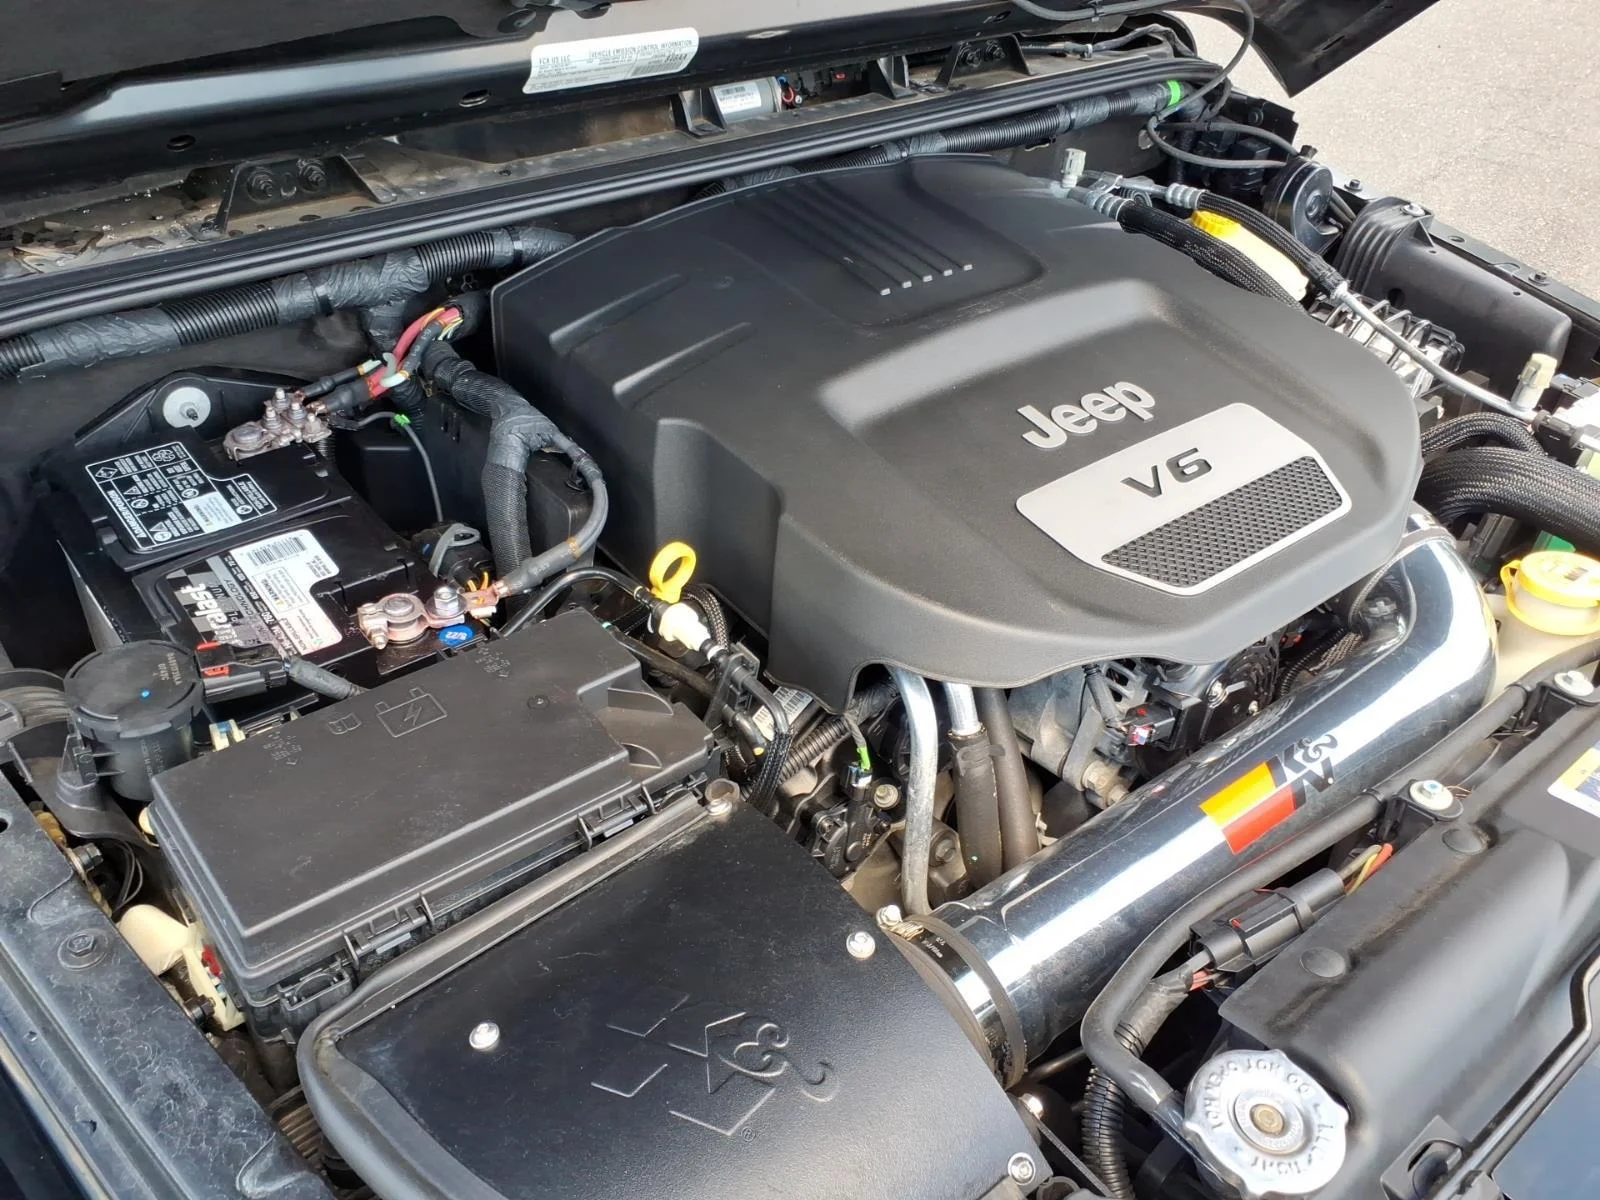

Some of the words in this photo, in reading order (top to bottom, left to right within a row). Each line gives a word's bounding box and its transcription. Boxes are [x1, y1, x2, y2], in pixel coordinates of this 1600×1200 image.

[591, 49, 611, 58] VEHICLE
[612, 47, 636, 57] EMISSION
[660, 40, 692, 50] INFORMATION
[1016, 380, 1157, 449] Jeep
[1120, 447, 1212, 498] V6
